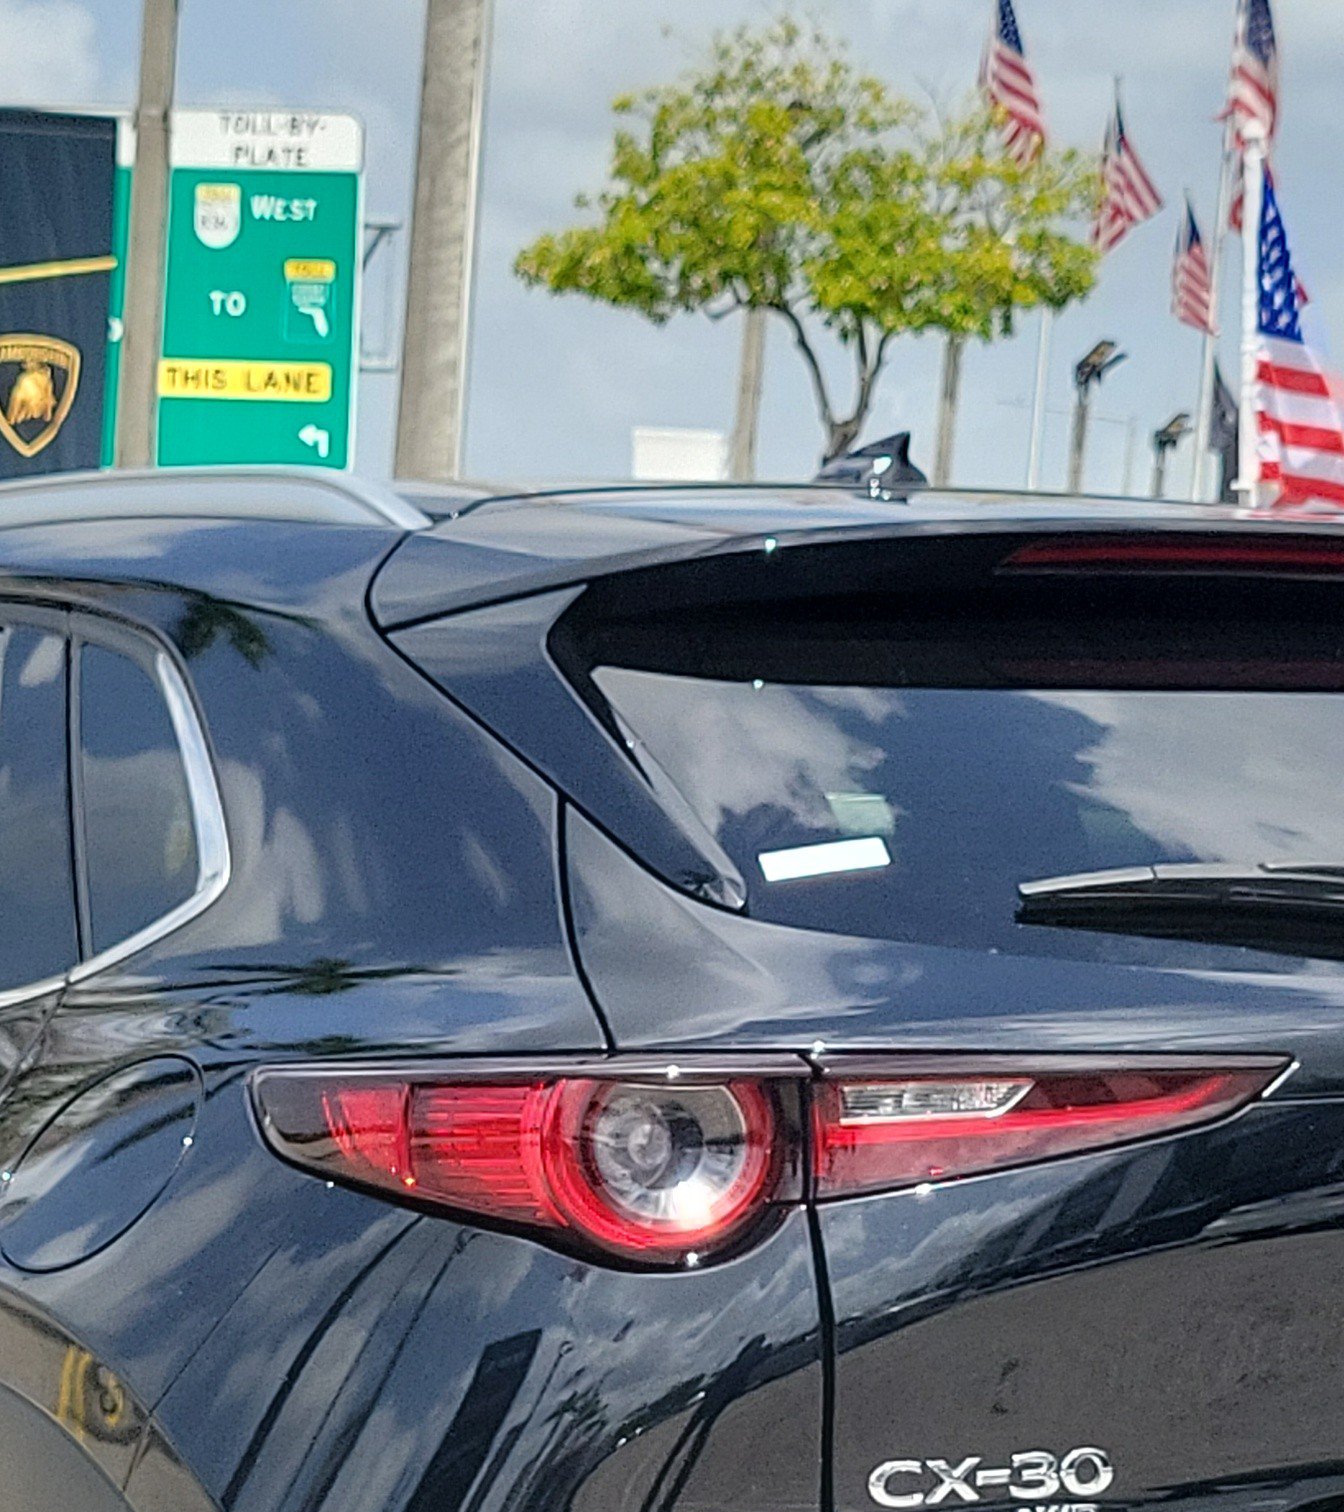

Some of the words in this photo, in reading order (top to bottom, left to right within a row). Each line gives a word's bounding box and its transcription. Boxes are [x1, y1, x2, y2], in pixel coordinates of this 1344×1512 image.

[234, 145, 311, 167] PLATE
[250, 194, 318, 222] WEST
[208, 289, 247, 317] TO
[166, 367, 227, 391] THIS
[246, 371, 322, 395] LANE
[867, 1446, 1114, 1508] CX-30
